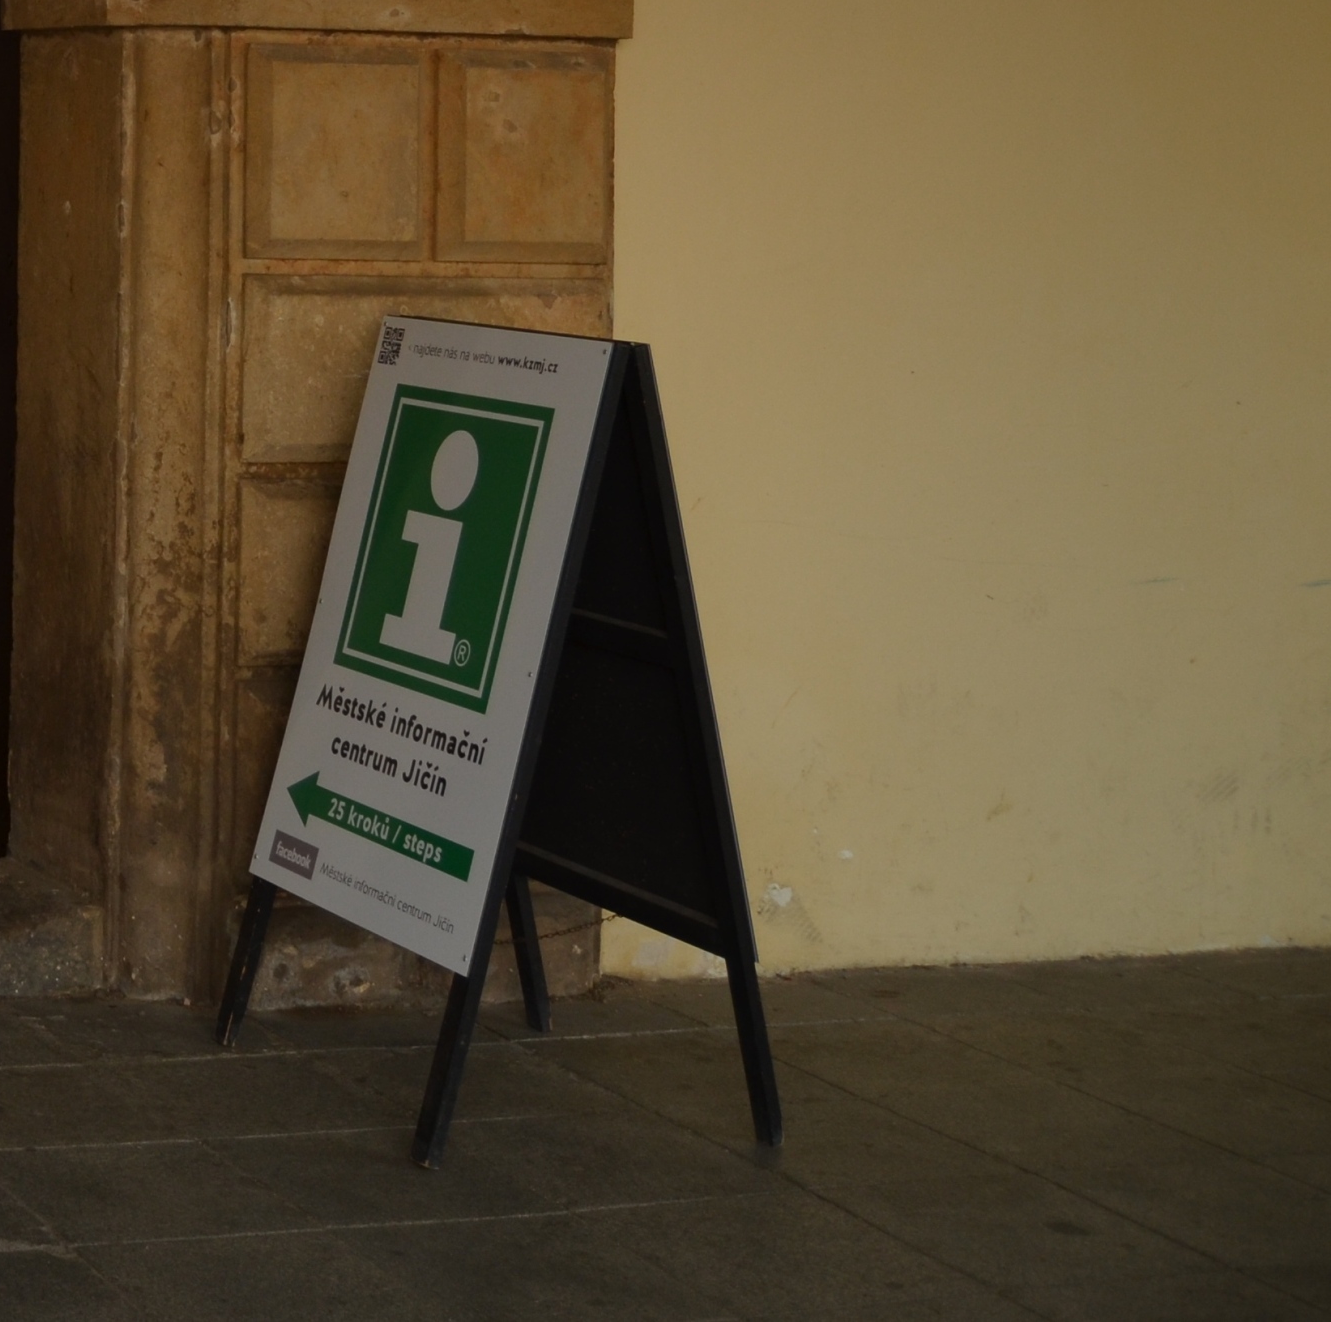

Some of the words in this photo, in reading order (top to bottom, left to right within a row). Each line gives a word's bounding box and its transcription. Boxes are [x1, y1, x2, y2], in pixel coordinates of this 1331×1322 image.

[412, 343, 442, 358] najdete
[443, 344, 458, 360] nás
[459, 350, 471, 361] na
[472, 351, 496, 365] webu
[497, 355, 559, 374] www.kzmj.cz
[315, 683, 386, 728] Městské
[390, 707, 488, 766] informační
[331, 736, 398, 778] centrum
[402, 759, 447, 797] Jičín
[275, 840, 311, 870] facebook
[327, 797, 345, 822] 25
[347, 805, 390, 840] kroků
[402, 826, 443, 864] steps
[319, 862, 353, 887] Městské
[353, 879, 397, 908] informační
[396, 898, 432, 924] centrum
[432, 914, 455, 934] Jičín
